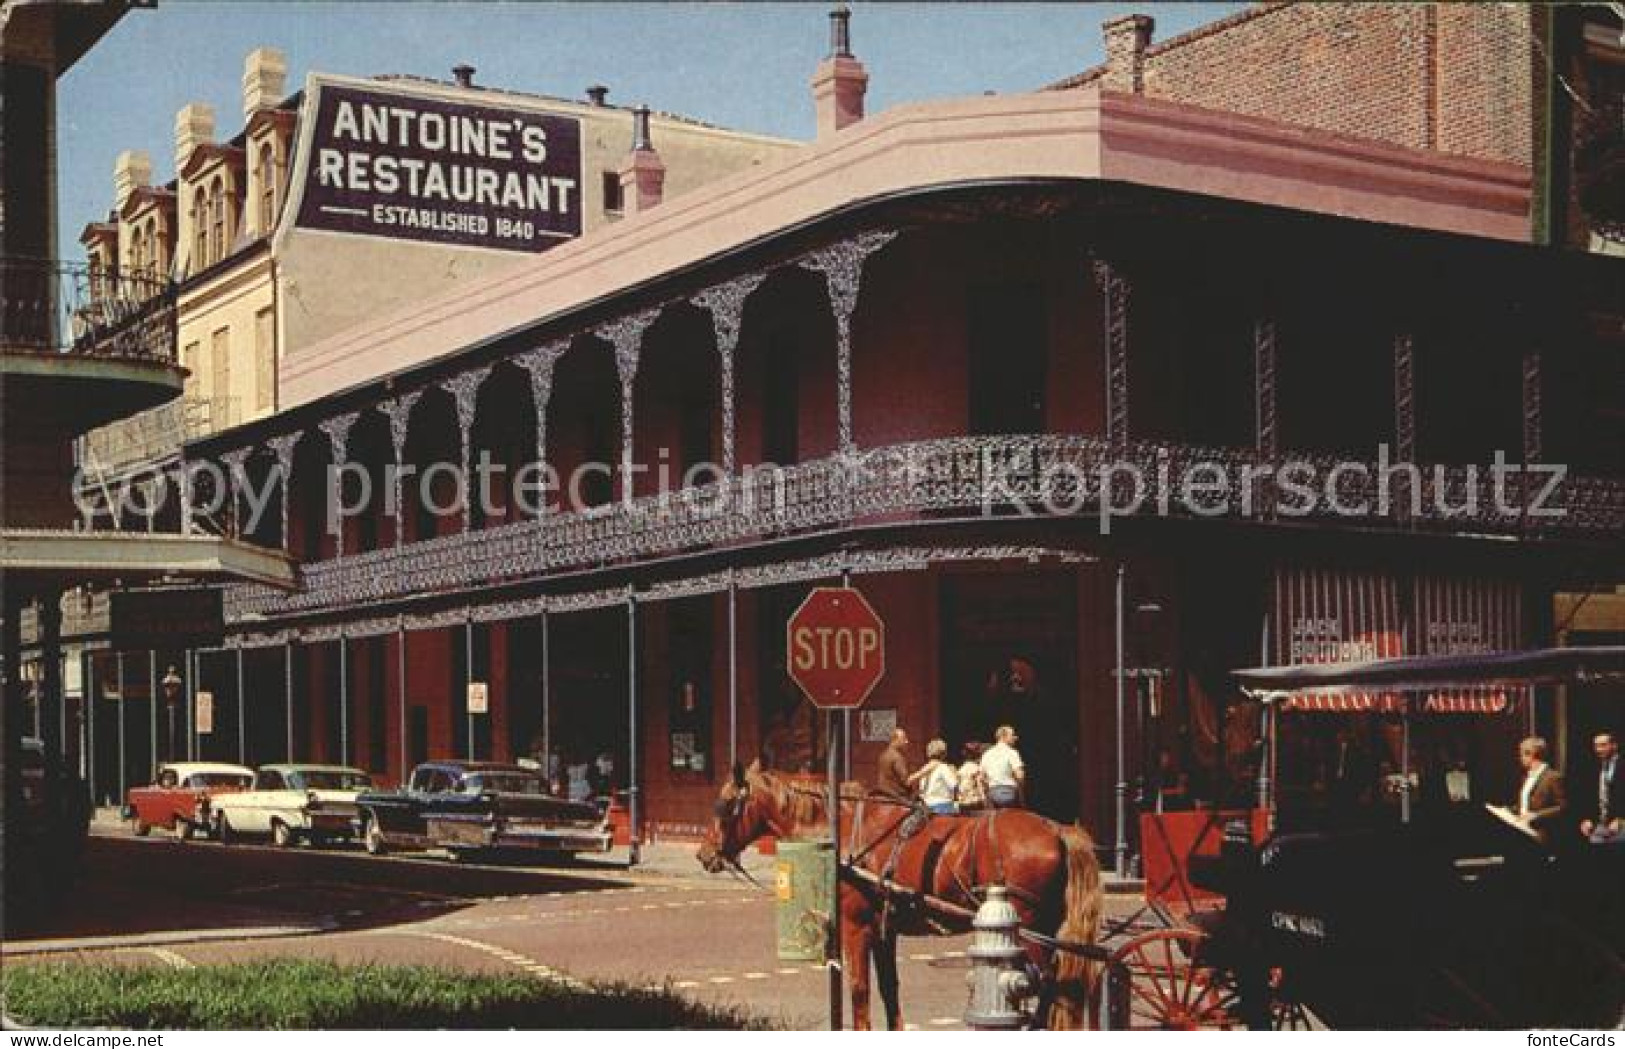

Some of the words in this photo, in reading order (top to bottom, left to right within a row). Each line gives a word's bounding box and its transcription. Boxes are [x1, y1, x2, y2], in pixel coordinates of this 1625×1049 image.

[333, 101, 547, 164] ANTOINE'S
[319, 148, 576, 214] RESTAURANT
[373, 204, 488, 235] ESTABLISHED
[496, 217, 534, 240] 1840
[795, 627, 878, 669] STOP
